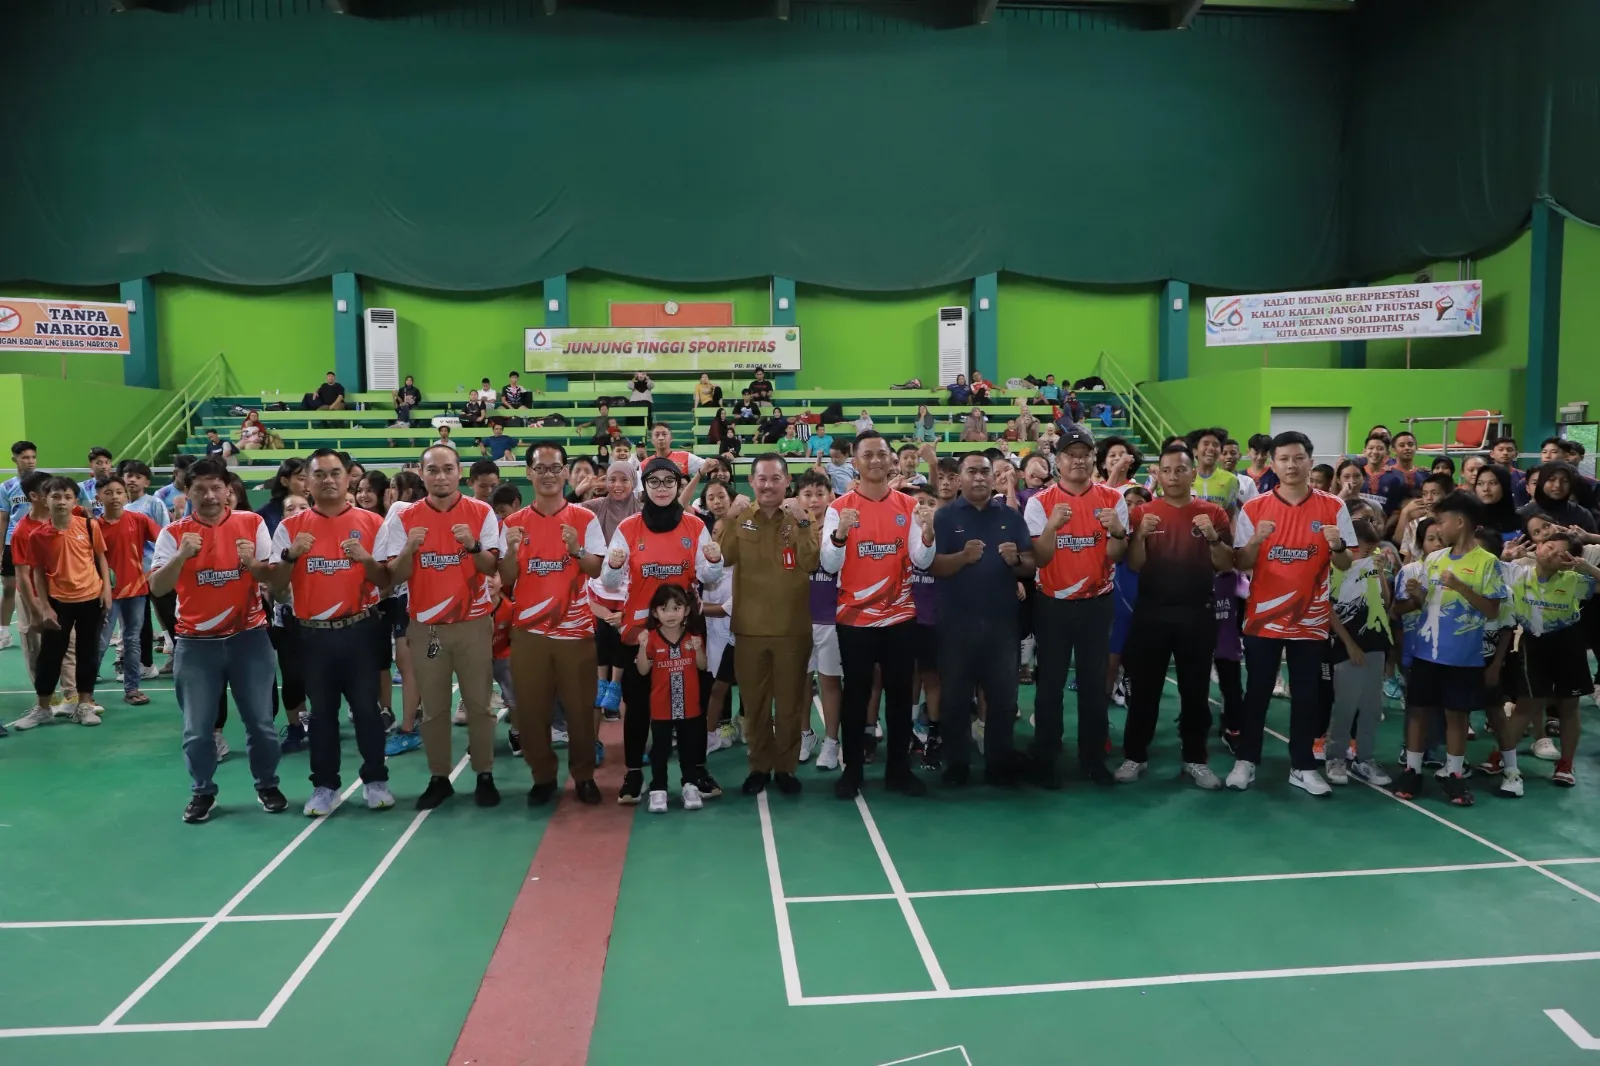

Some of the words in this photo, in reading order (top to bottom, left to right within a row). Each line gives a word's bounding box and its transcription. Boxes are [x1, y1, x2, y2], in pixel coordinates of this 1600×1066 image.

[1264, 297, 1295, 307] KALAU
[1298, 294, 1342, 304] MENANG
[1346, 290, 1420, 302] BERPRESTASI
[49, 308, 108, 322] TANPA
[1252, 310, 1286, 318] KALAU
[1288, 308, 1325, 316] KALAH
[1328, 304, 1372, 314] JANGAN
[1376, 300, 1434, 312] FRUSTASI
[1262, 320, 1296, 328] KALAH
[1298, 317, 1344, 326] MENANG
[1348, 313, 1420, 324] SOLIDARITAS
[36, 323, 122, 336] NARKOBA
[1276, 328, 1298, 338] KITA
[1300, 326, 1337, 336] GALANG
[1340, 324, 1404, 334] SPORTIFITAS
[45, 339, 60, 347] LNG
[86, 340, 118, 348] NARKOBA
[562, 342, 633, 354] JUNJUNG
[636, 341, 685, 354] TINGGI
[688, 340, 776, 353] SPORTIFITAS
